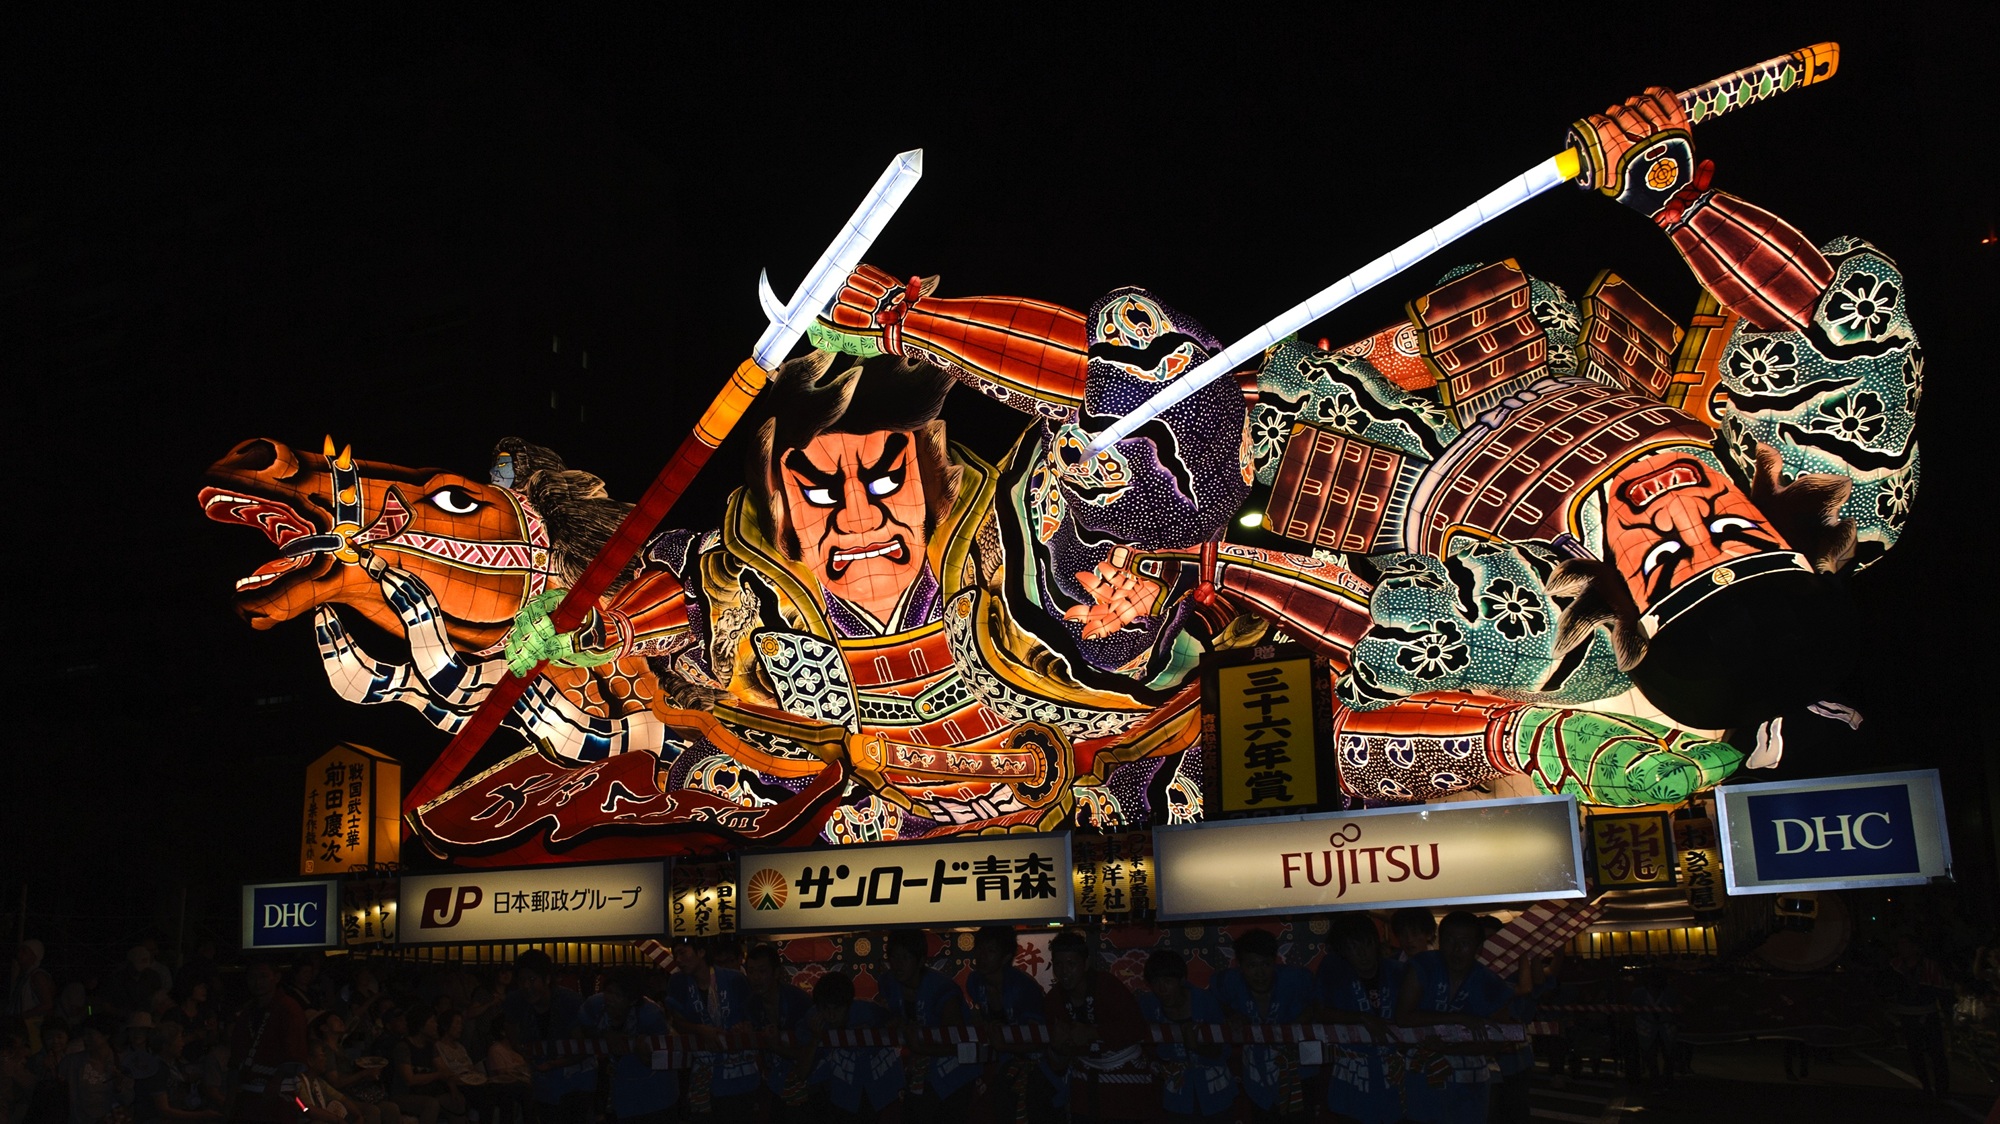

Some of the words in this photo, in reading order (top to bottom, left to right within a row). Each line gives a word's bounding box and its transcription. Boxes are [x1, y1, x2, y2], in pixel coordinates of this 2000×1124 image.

[1252, 645, 1276, 660] 贈
[1243, 667, 1295, 805] 三十六年賞
[319, 760, 347, 863] 前田慶次
[345, 763, 364, 851] 戦国武士華
[1771, 812, 1893, 855] DHC
[795, 852, 1057, 909] サンロード青森
[1101, 835, 1126, 910] 東洋社
[1281, 842, 1441, 899] FUJITSU
[263, 901, 318, 929] DHC
[420, 885, 484, 929] JP
[493, 885, 643, 914] 日本郵政グループ
